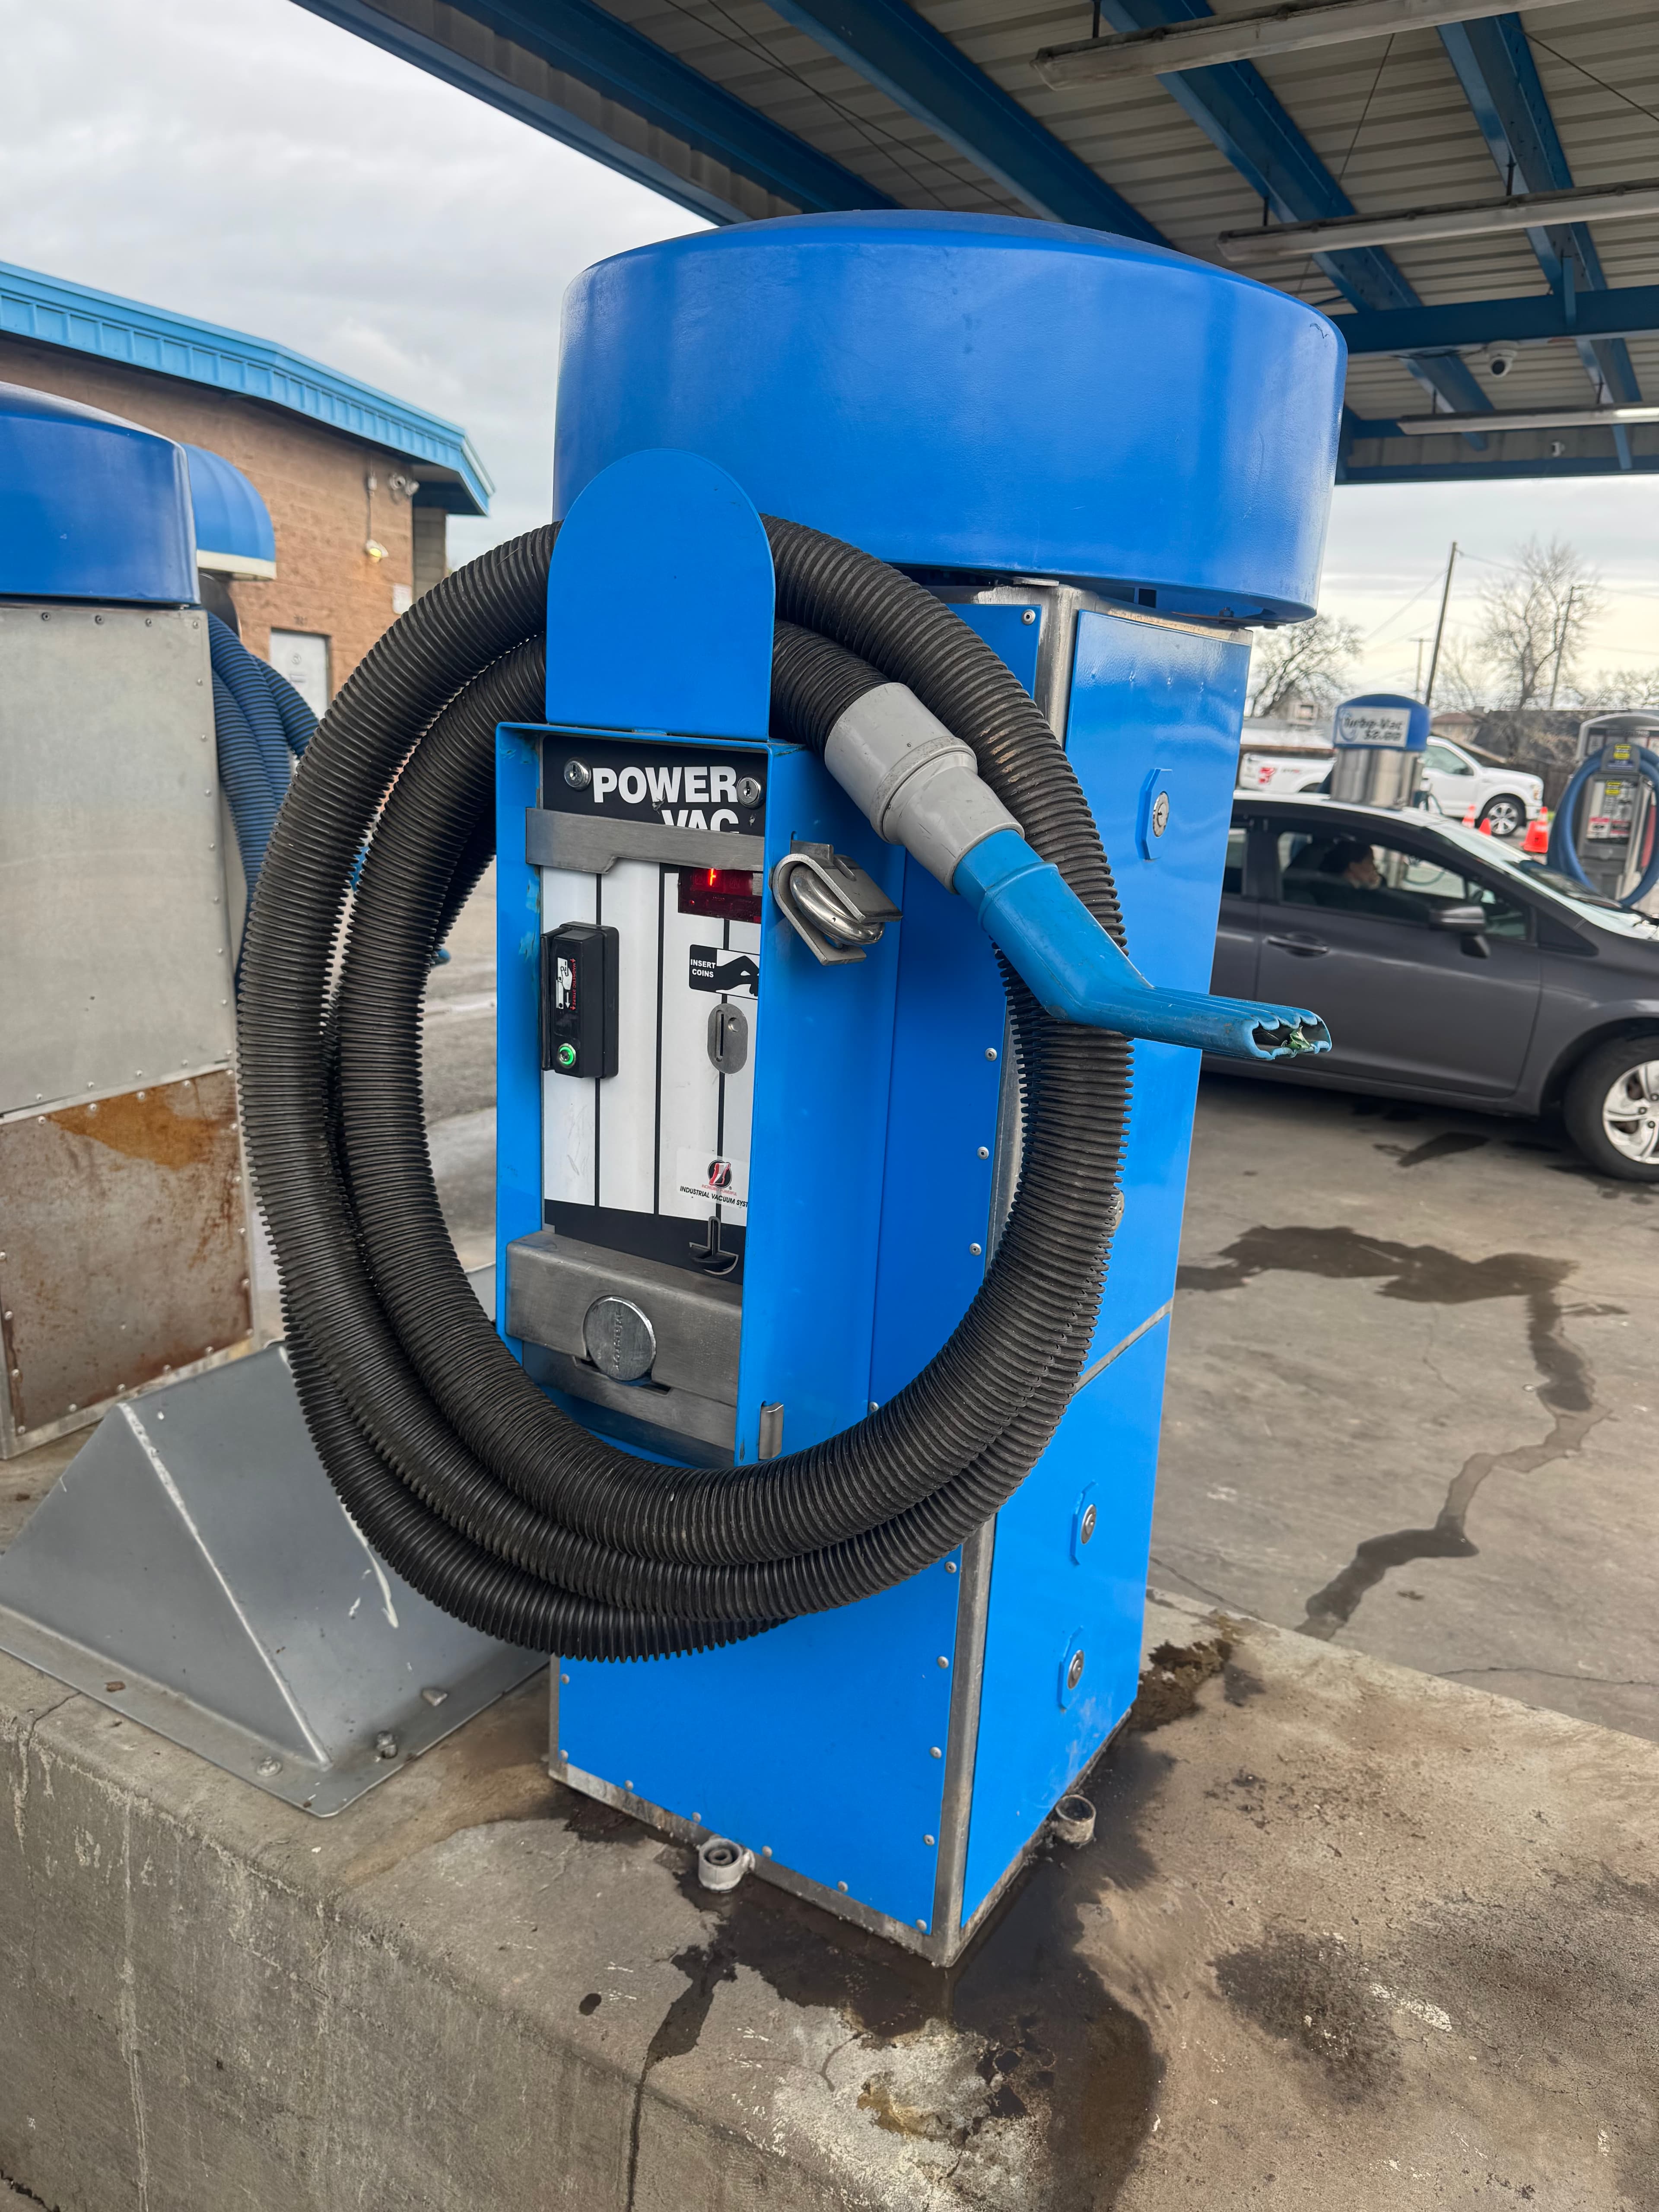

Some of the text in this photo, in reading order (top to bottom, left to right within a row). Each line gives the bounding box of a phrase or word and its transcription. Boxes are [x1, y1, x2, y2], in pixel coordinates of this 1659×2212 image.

[592, 766, 738, 804] POWER
[690, 959, 716, 969] INSERT
[692, 969, 714, 978] COINS
[680, 1186, 709, 1198] INDUSTRIAL
[712, 1193, 735, 1205] VACUUM
